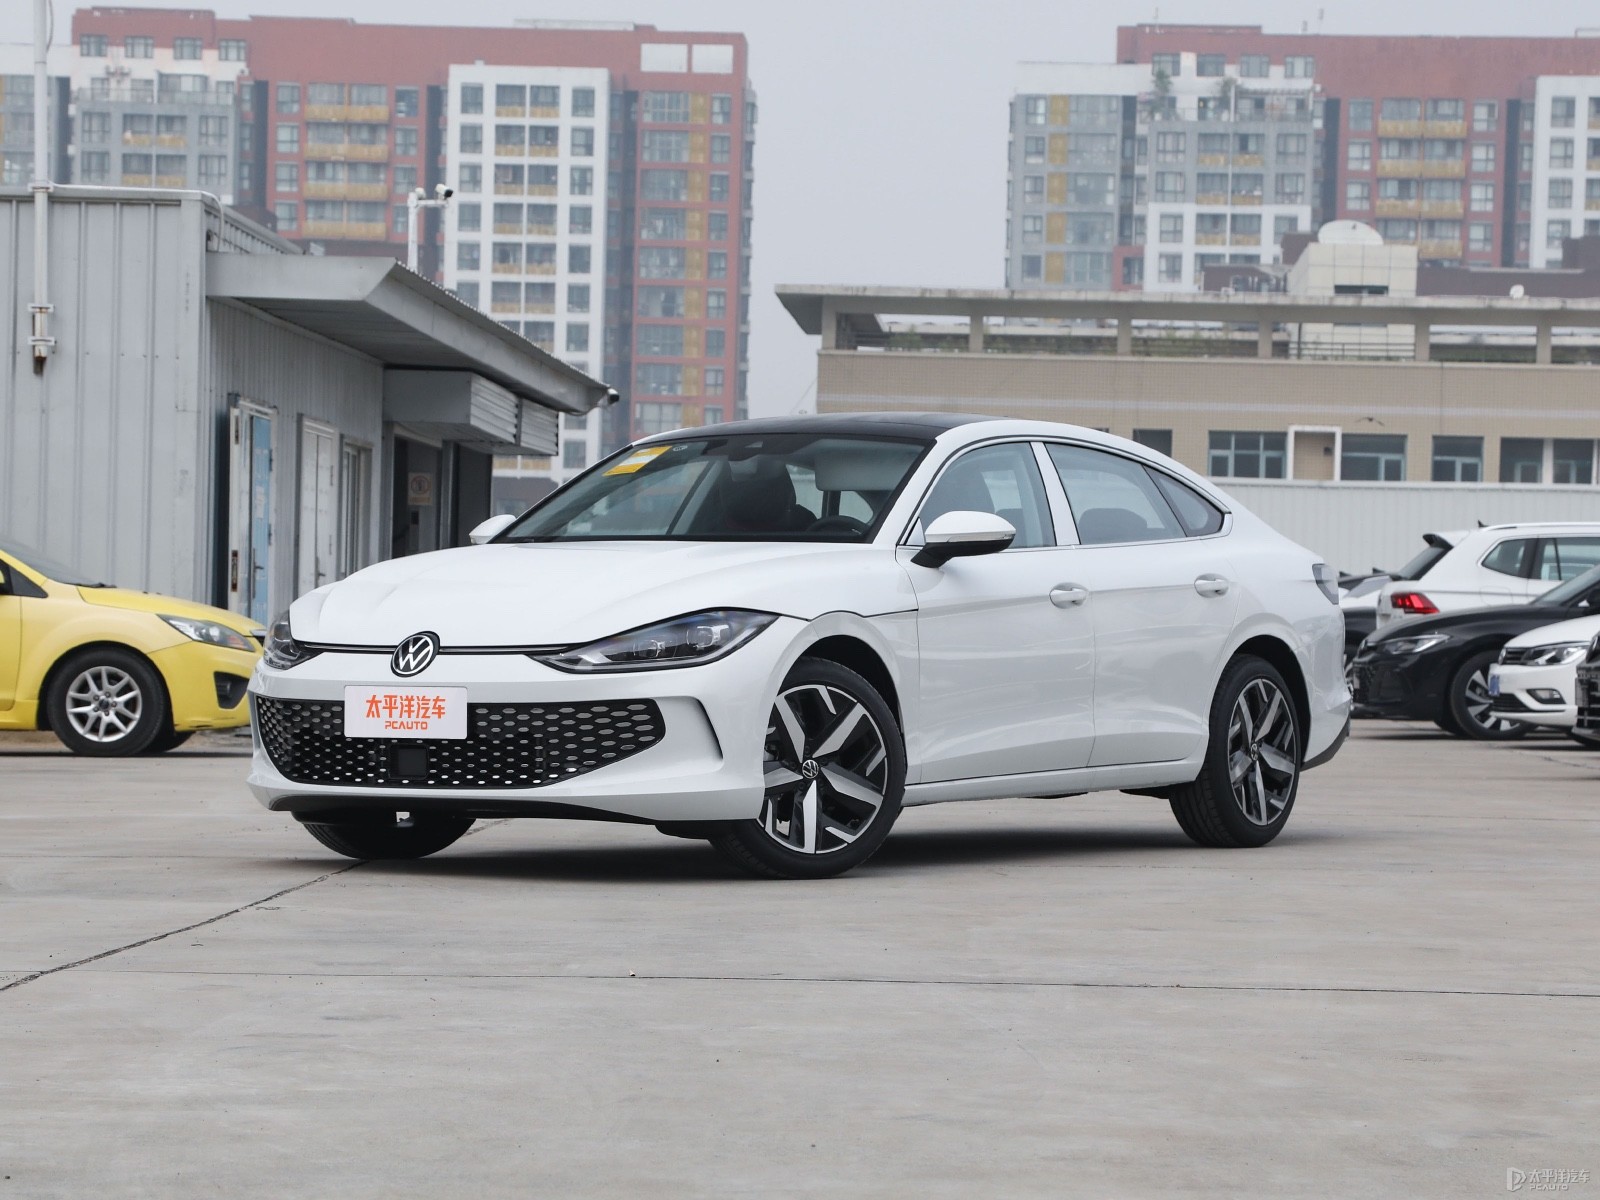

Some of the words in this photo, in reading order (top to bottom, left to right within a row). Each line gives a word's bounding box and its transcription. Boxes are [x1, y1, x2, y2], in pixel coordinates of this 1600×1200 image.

[366, 694, 446, 719] 太平洋汽车
[385, 721, 428, 730] PCAUTO
